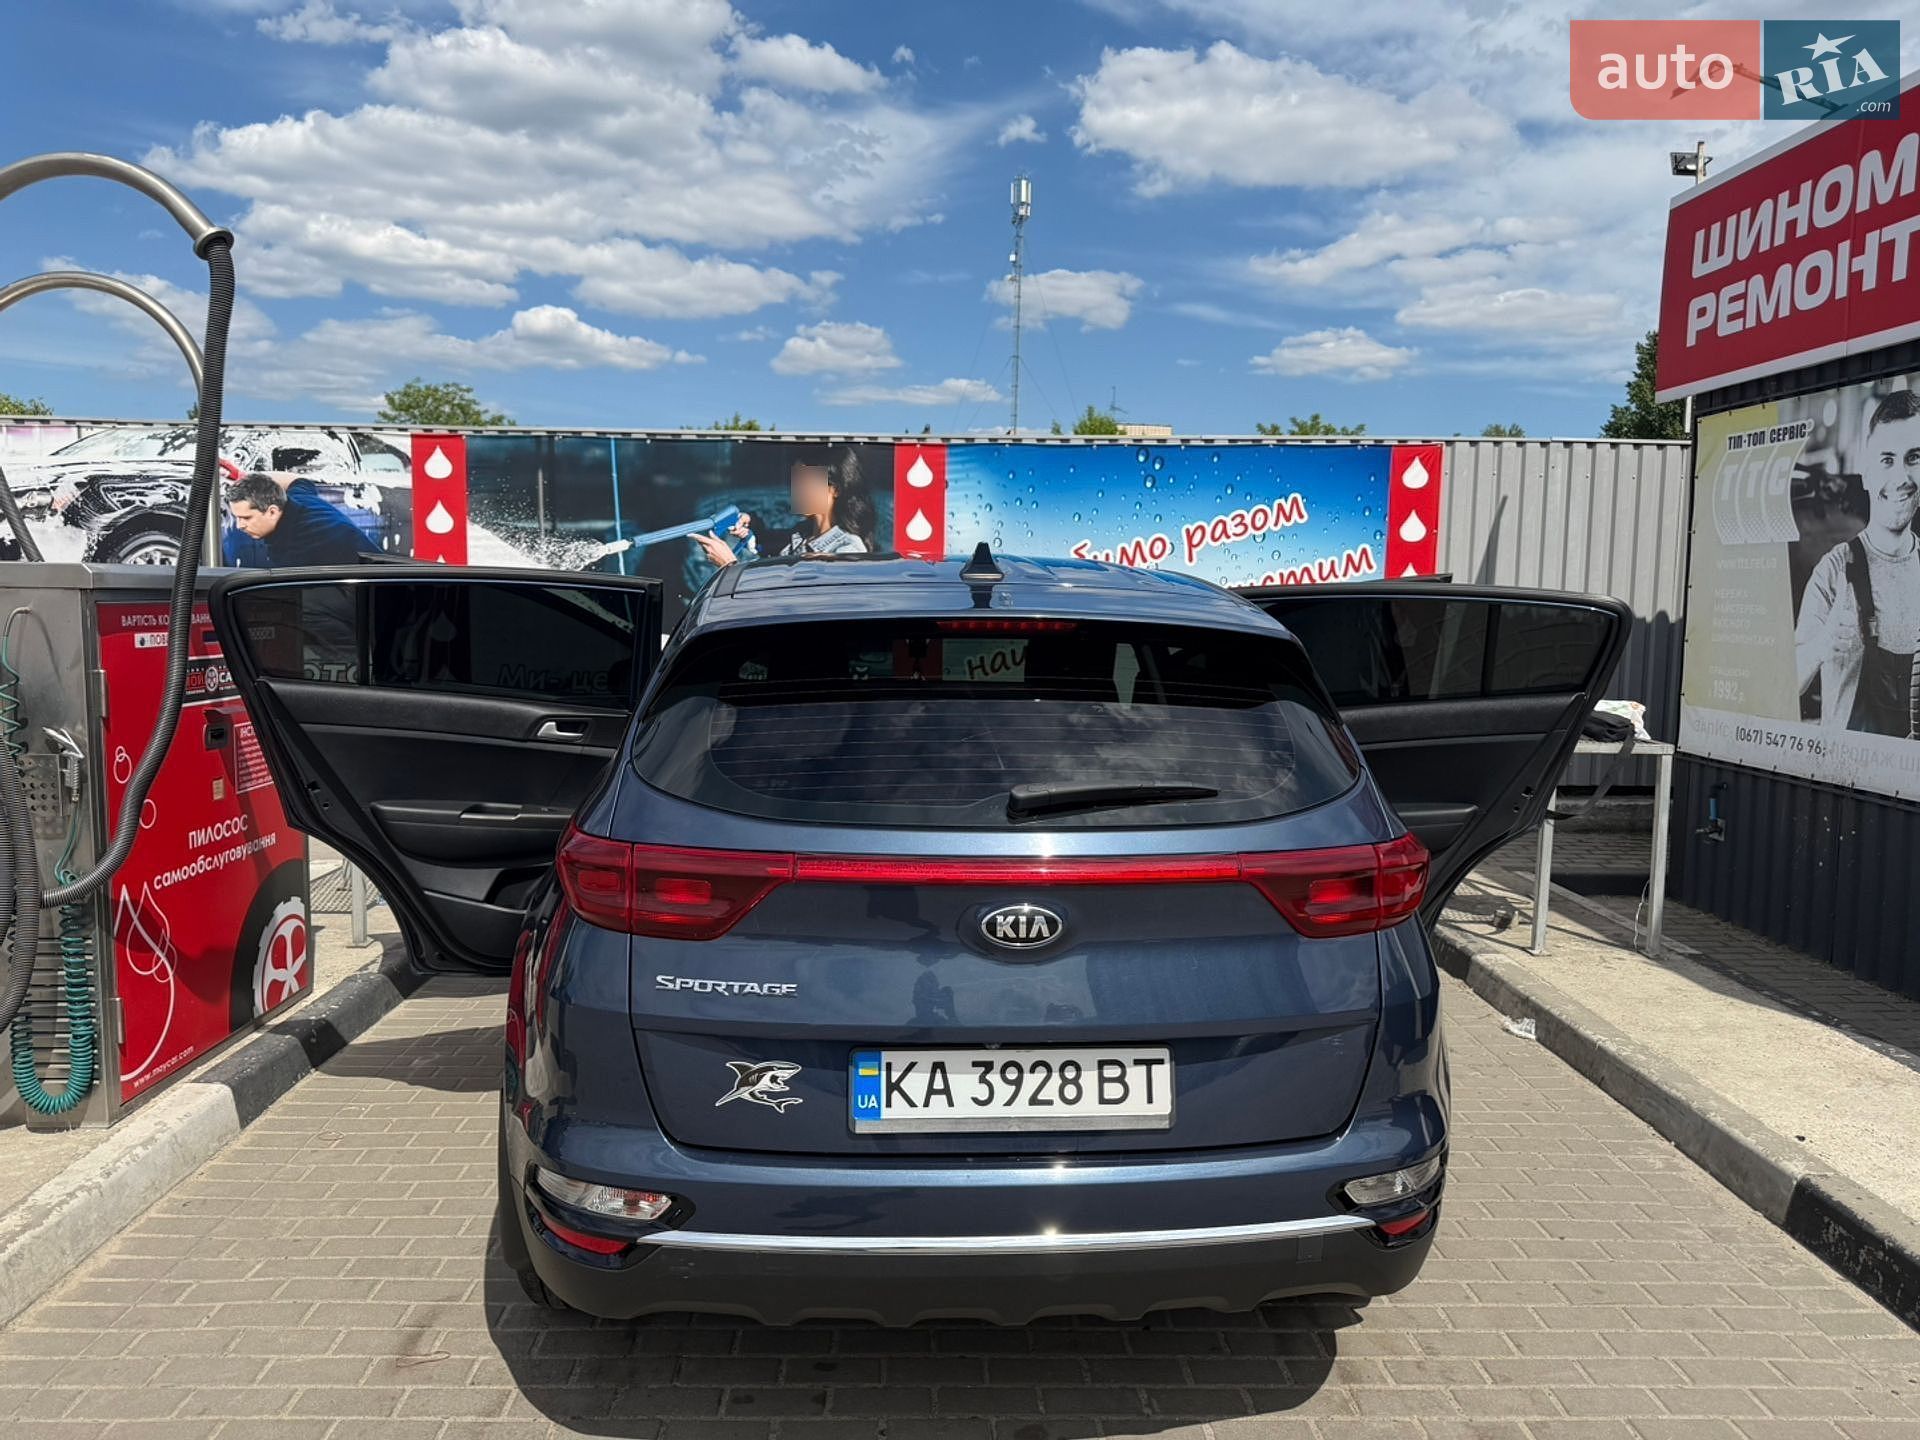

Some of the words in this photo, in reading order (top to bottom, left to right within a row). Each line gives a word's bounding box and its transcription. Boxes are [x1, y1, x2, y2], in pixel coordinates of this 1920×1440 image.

[1691, 131, 1920, 280] ШИНОМ
[1685, 213, 1920, 348] РЕМОНТ
[1769, 422, 1807, 444] СЕРВІС
[1184, 494, 1306, 564] разом
[1735, 725, 1763, 745] (067)
[1766, 731, 1787, 749] 547
[1789, 735, 1804, 752] 76
[188, 813, 249, 850] ПИЛОСОС
[152, 831, 277, 891] самообслуговування
[995, 914, 1052, 938] KIA
[655, 974, 798, 997] SPORTAGE
[885, 1060, 955, 1109] KA
[970, 1059, 1084, 1108] 3928
[1096, 1057, 1165, 1106] BT
[857, 1094, 880, 1110] UA
